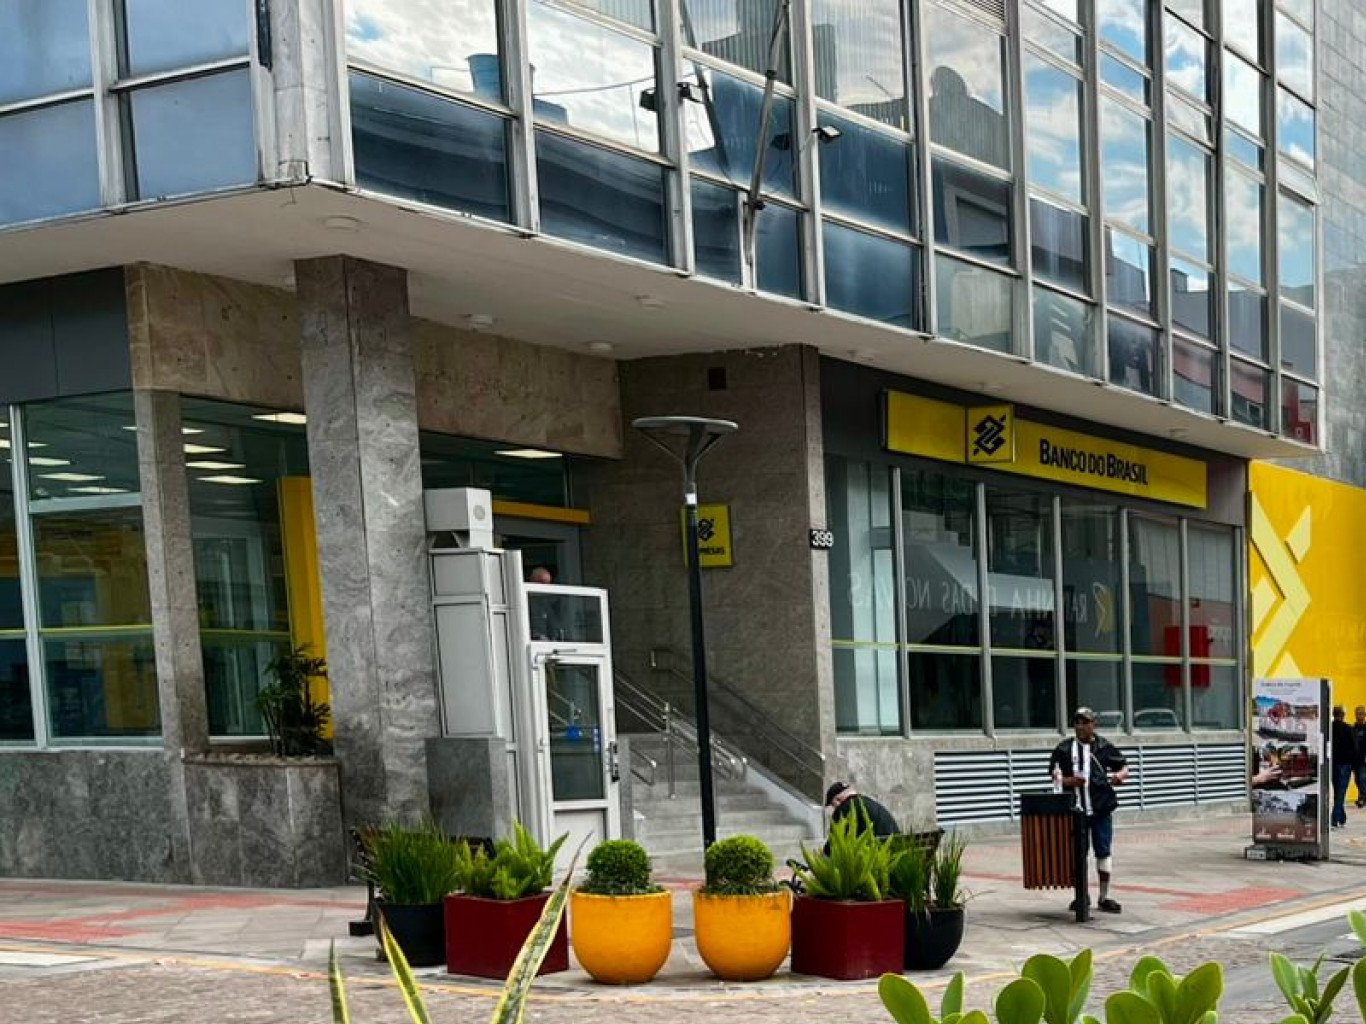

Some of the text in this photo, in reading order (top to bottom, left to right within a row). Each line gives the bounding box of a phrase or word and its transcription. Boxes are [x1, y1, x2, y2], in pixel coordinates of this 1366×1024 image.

[1040, 438, 1149, 485] BANCO DO BRASIL
[812, 530, 834, 547] 399
